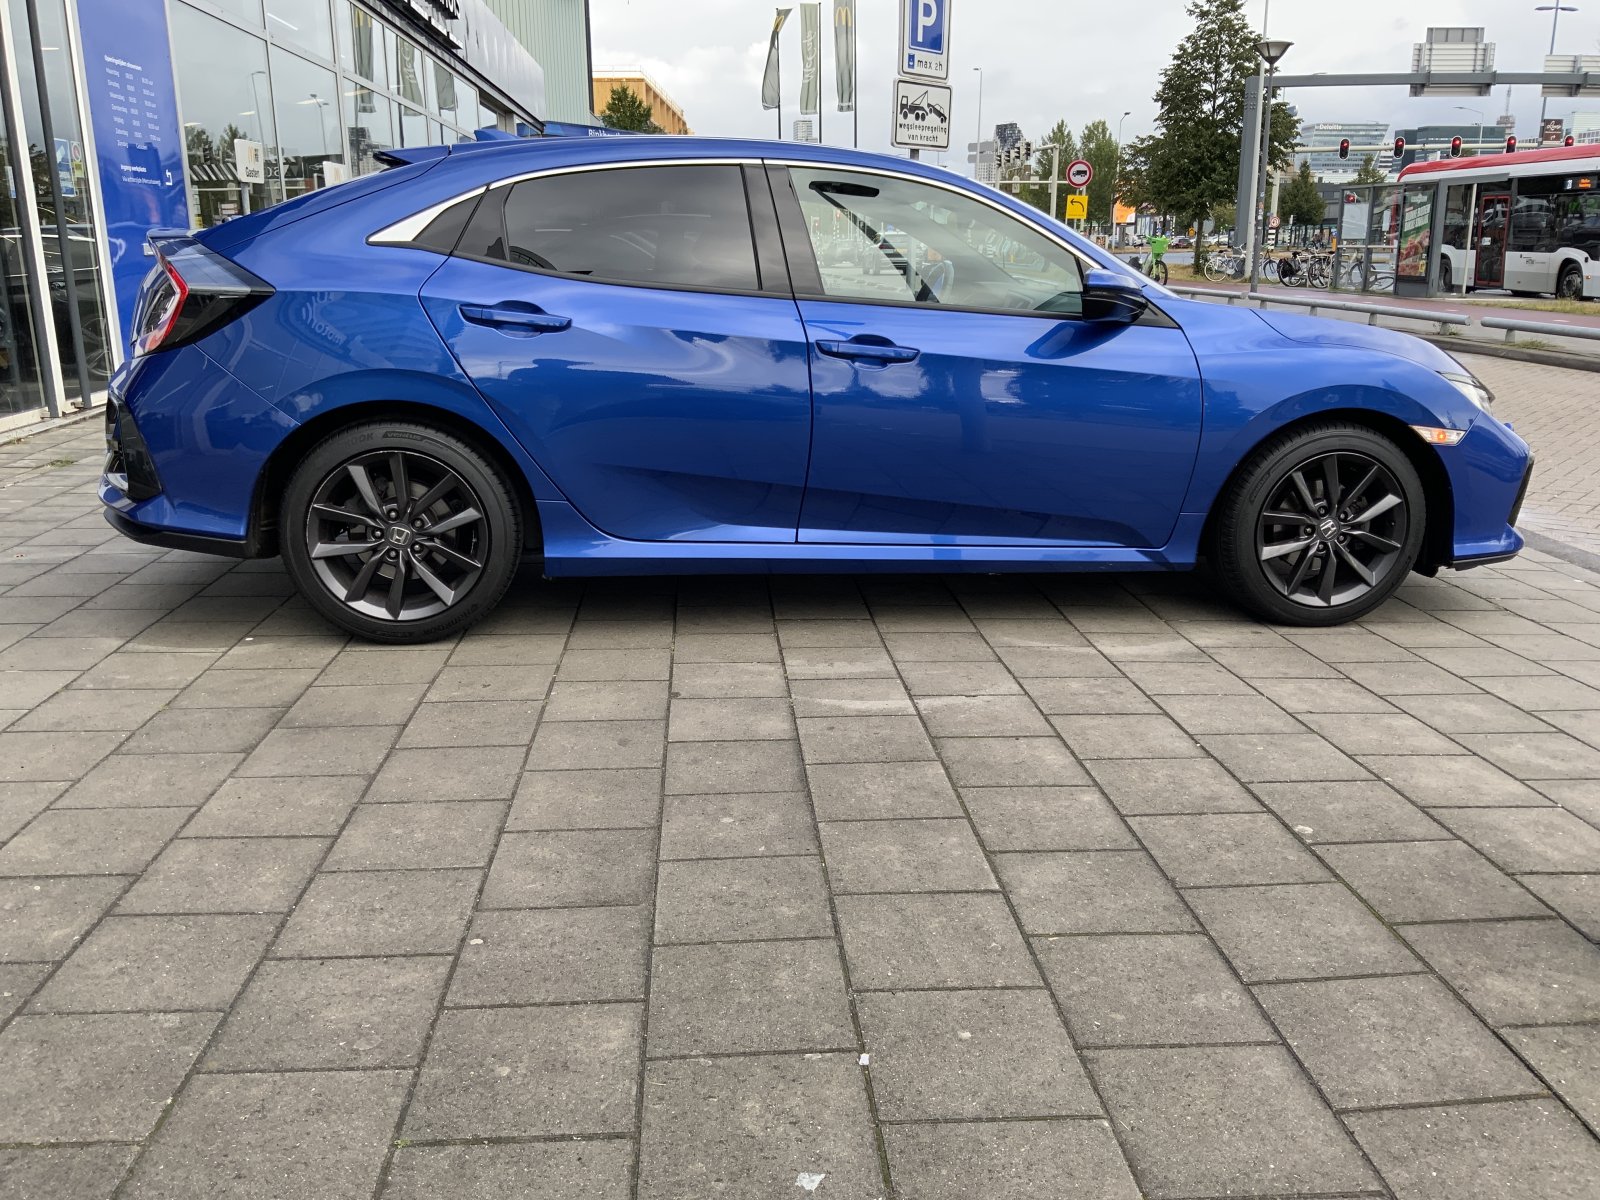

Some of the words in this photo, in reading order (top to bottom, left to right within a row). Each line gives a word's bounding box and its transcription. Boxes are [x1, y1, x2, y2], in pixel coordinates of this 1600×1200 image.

[917, 59, 932, 70] max
[935, 62, 943, 72] 2h
[898, 122, 947, 135] wegsleepregeling
[919, 134, 938, 142] kracht
